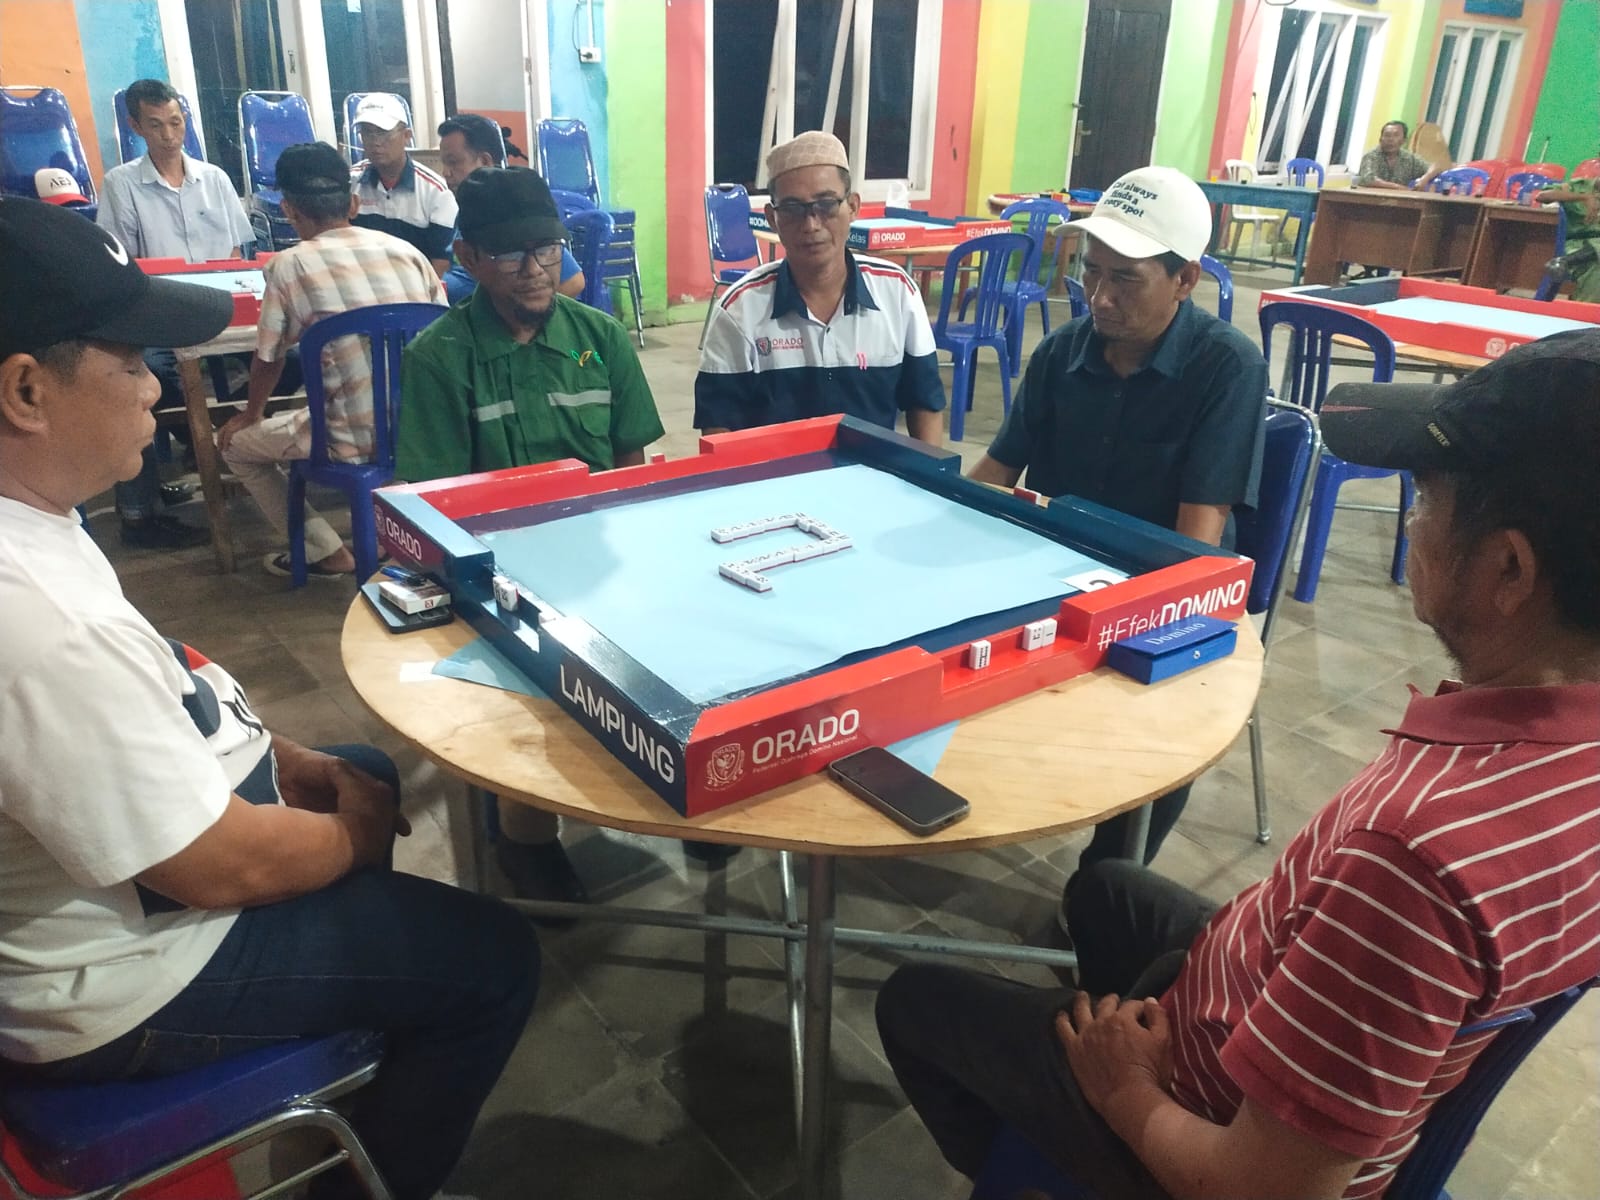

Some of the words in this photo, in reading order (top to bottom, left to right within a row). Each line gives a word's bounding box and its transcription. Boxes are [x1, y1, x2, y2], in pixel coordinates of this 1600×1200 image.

[1124, 183, 1157, 200] always
[1121, 203, 1144, 217] spot
[880, 231, 906, 242] ORADO
[772, 337, 804, 346] ORADO
[386, 517, 422, 561] ORADO
[1144, 623, 1206, 645] Domino
[560, 664, 675, 784] LAMPUNG
[752, 708, 859, 765] ORADO
